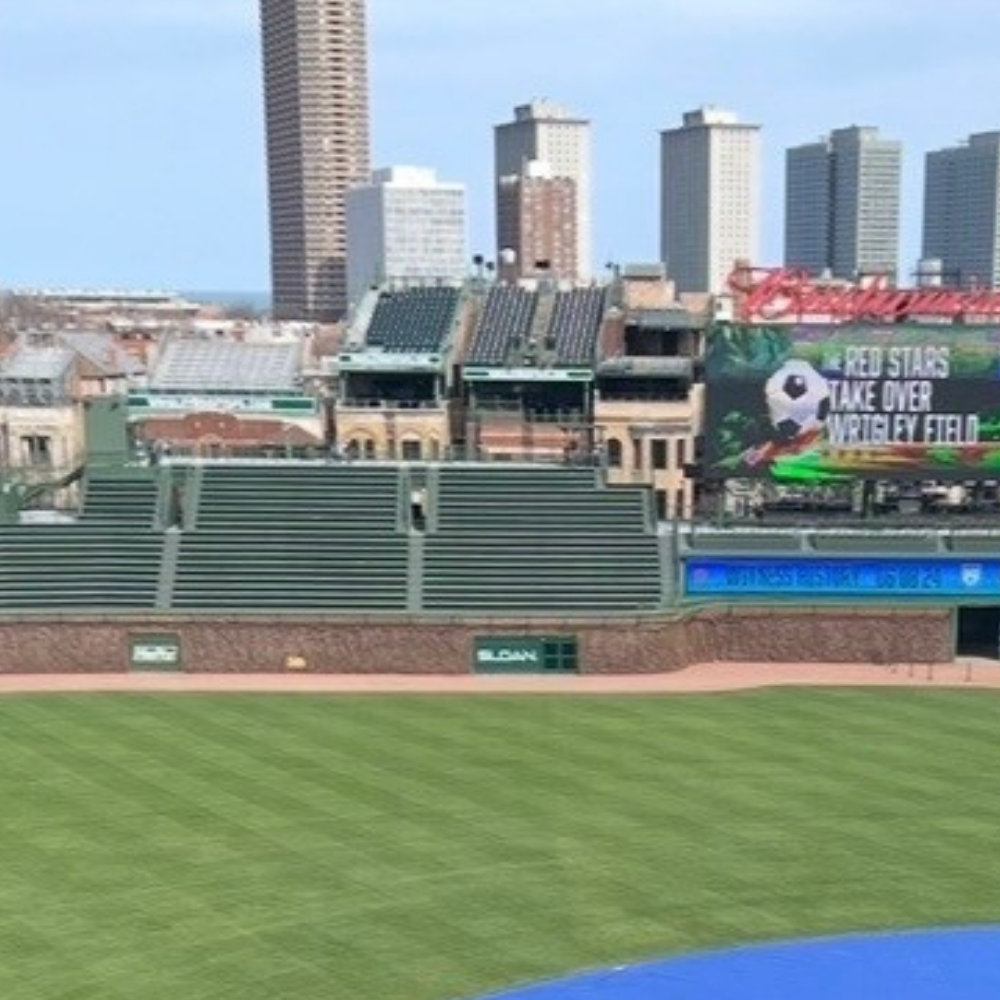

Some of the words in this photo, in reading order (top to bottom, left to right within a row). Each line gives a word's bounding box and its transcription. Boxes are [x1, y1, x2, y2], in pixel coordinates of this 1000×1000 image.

[846, 346, 881, 377] RED
[888, 346, 950, 378] STARS
[829, 380, 876, 411] TAKE
[882, 380, 933, 412] OVER
[826, 413, 918, 444] WRIGLEY
[923, 413, 980, 444] FIELD
